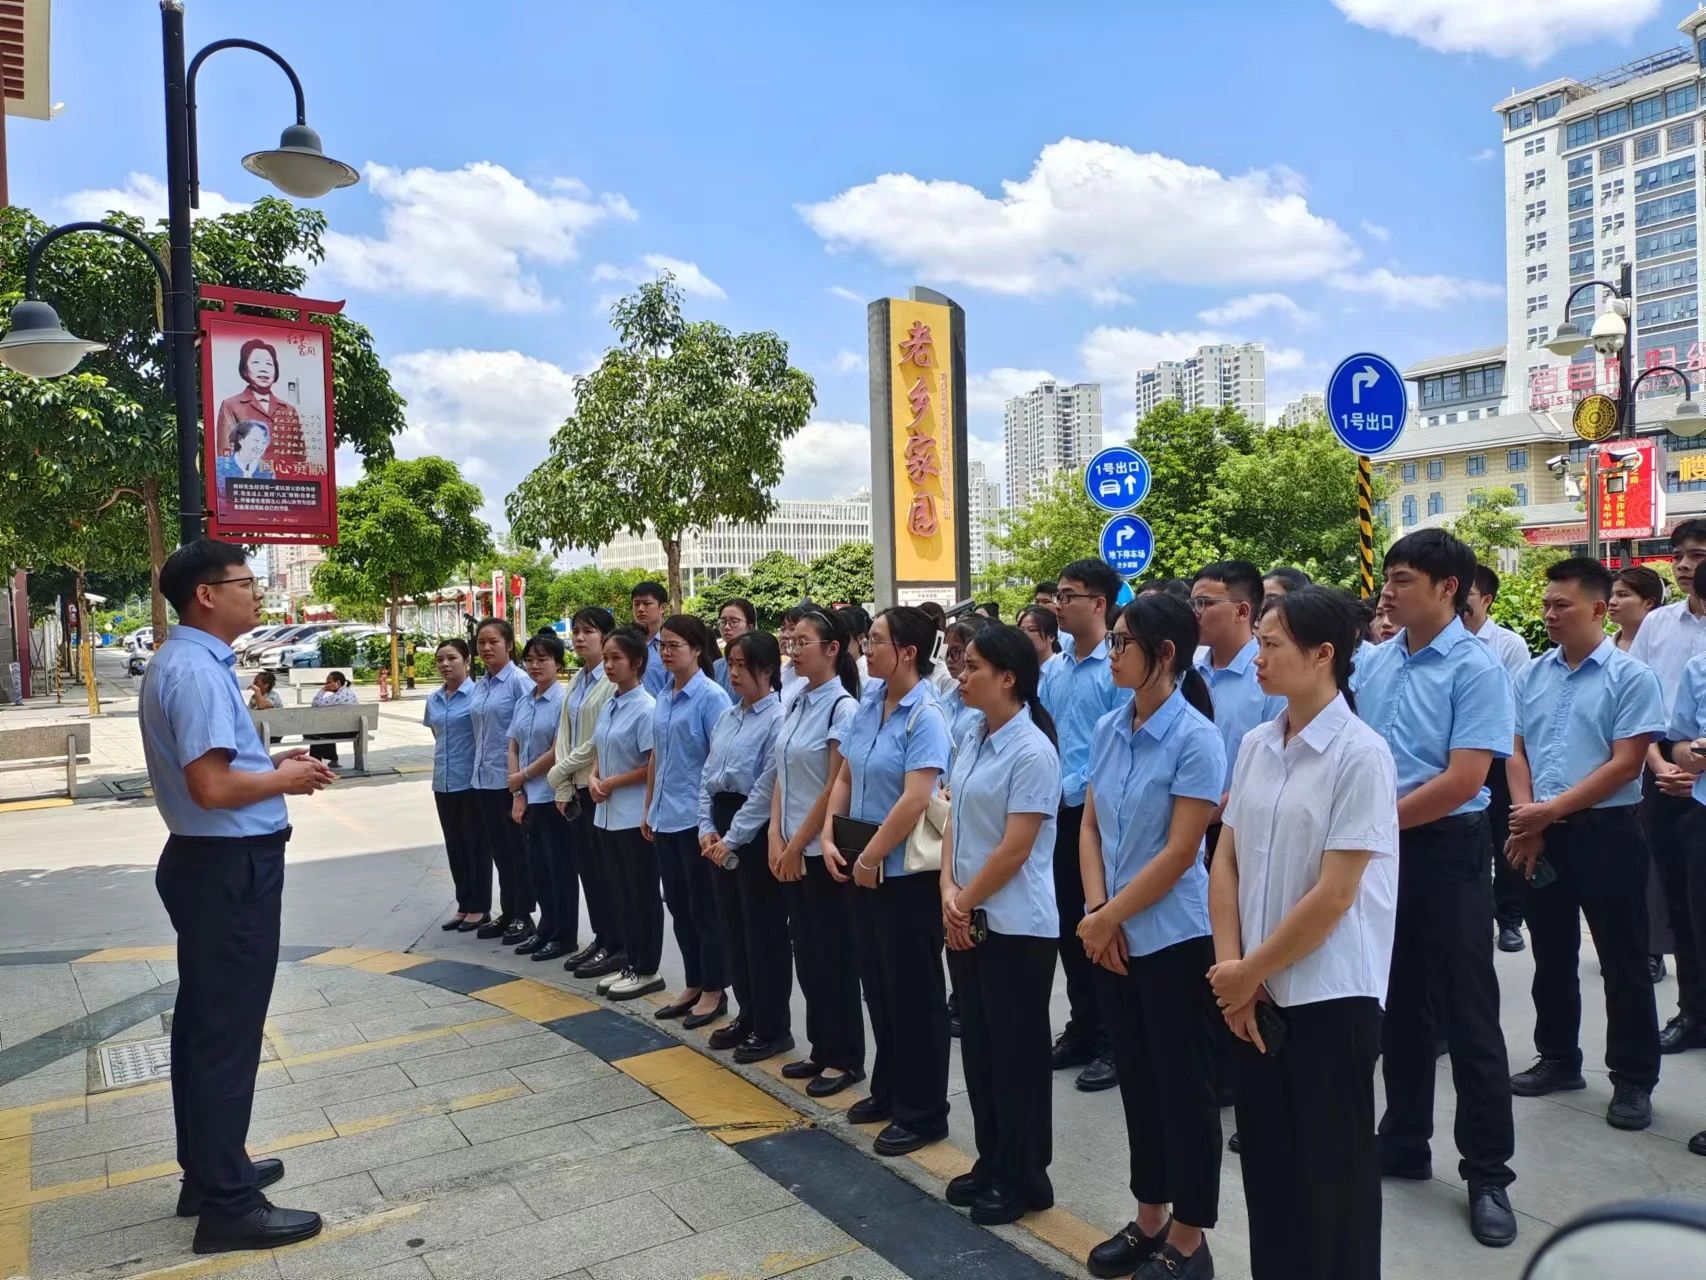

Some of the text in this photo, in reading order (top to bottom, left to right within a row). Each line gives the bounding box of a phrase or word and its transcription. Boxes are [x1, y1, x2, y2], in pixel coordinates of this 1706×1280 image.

[1341, 412, 1394, 431] 1号出口
[1095, 461, 1140, 475] 1号出口
[1108, 549, 1146, 560] 地下停车场
